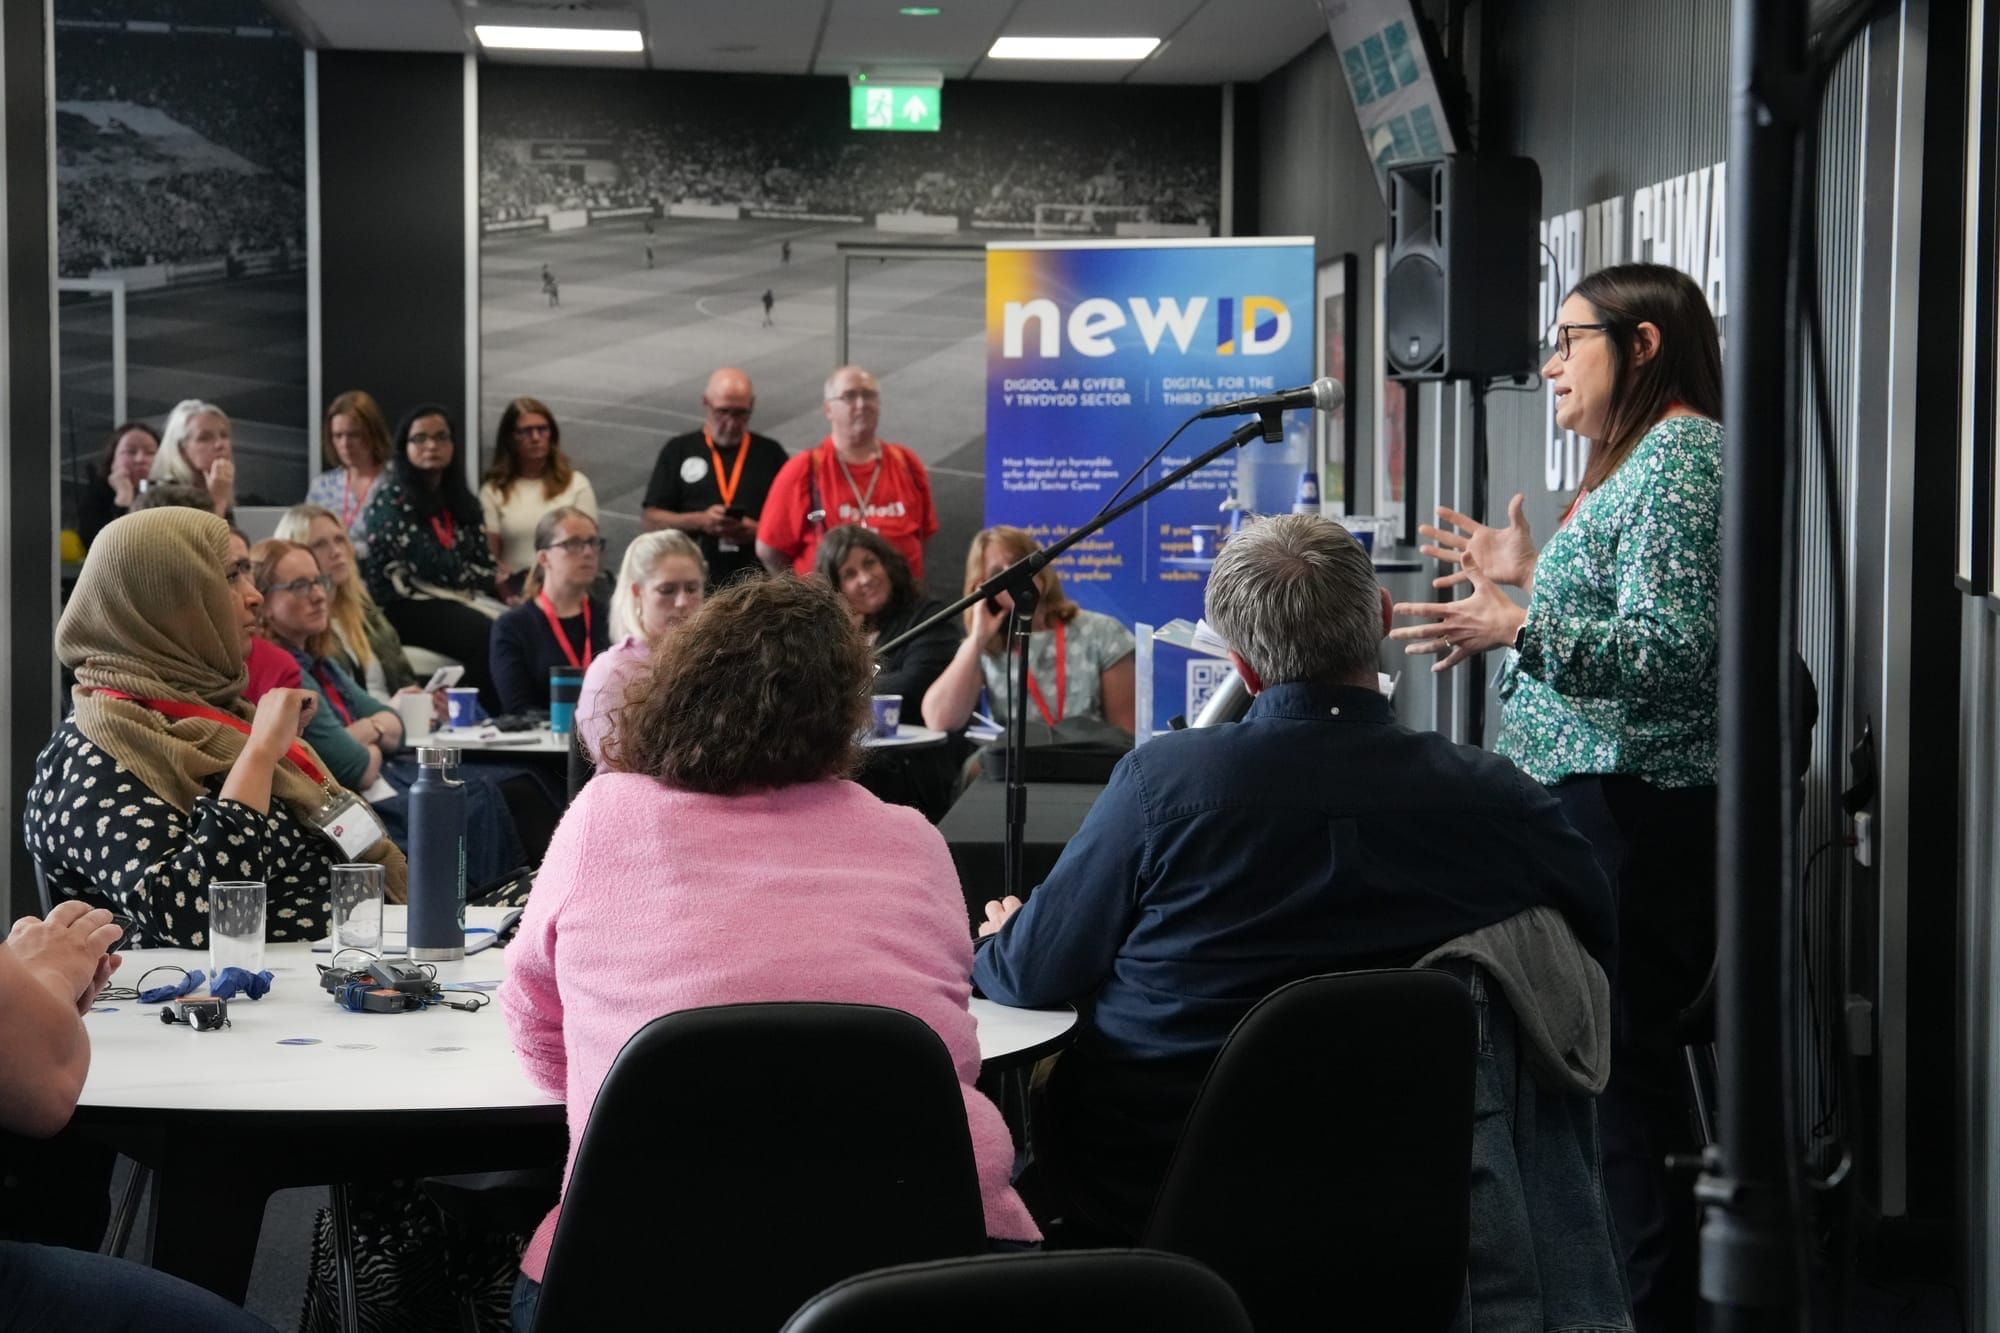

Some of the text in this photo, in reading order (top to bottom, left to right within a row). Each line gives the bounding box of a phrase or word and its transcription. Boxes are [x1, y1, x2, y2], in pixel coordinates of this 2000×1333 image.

[1003, 376, 1126, 392] DIGIDOL AR GYFER
[1162, 375, 1275, 391] DIGITAL FOR THE
[1003, 392, 1131, 407] Y TRYDYDD SECTOR
[1163, 392, 1204, 406] THIRD
